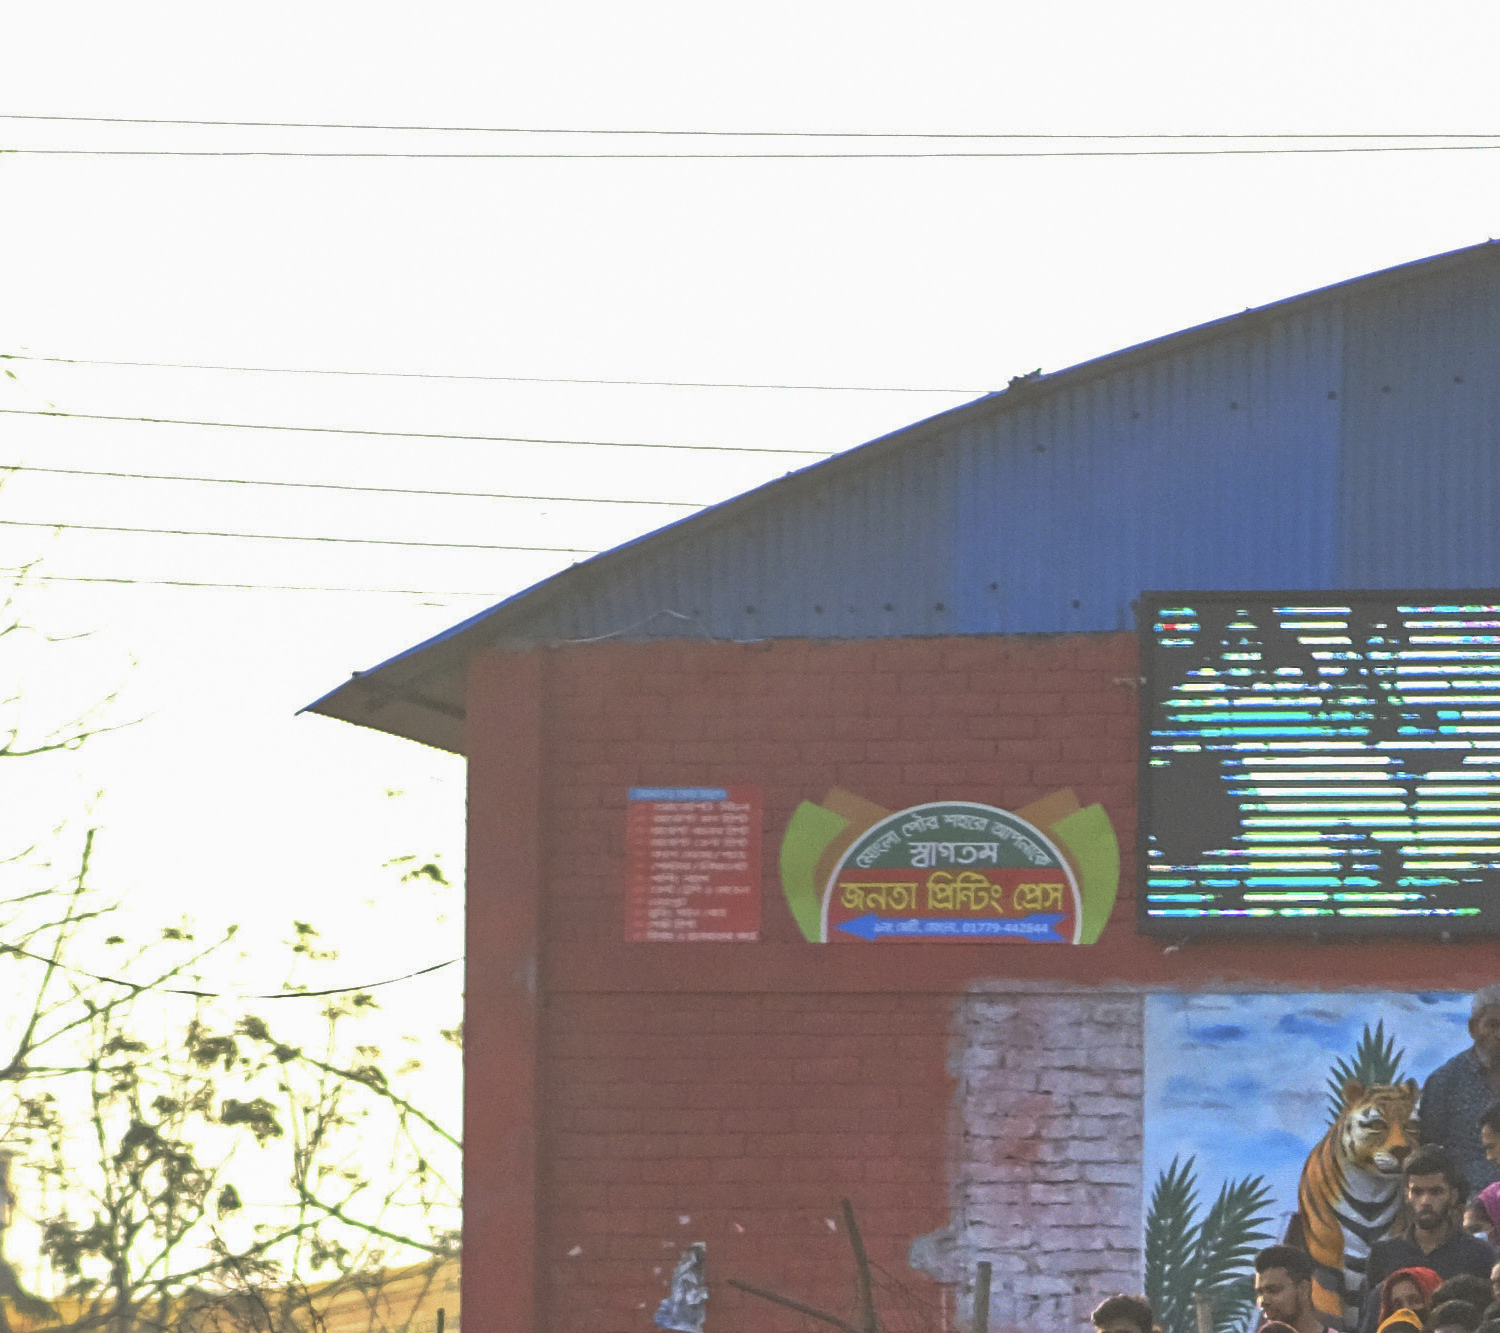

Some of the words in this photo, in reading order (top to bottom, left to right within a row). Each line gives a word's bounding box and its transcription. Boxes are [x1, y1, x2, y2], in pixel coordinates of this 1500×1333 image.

[902, 812, 940, 838] পৌর
[907, 841, 1000, 868] স্বাগতম
[839, 882, 919, 911] জনতা
[925, 870, 1005, 914] প্রিন্টিং
[1012, 882, 1065, 911] প্রেস
